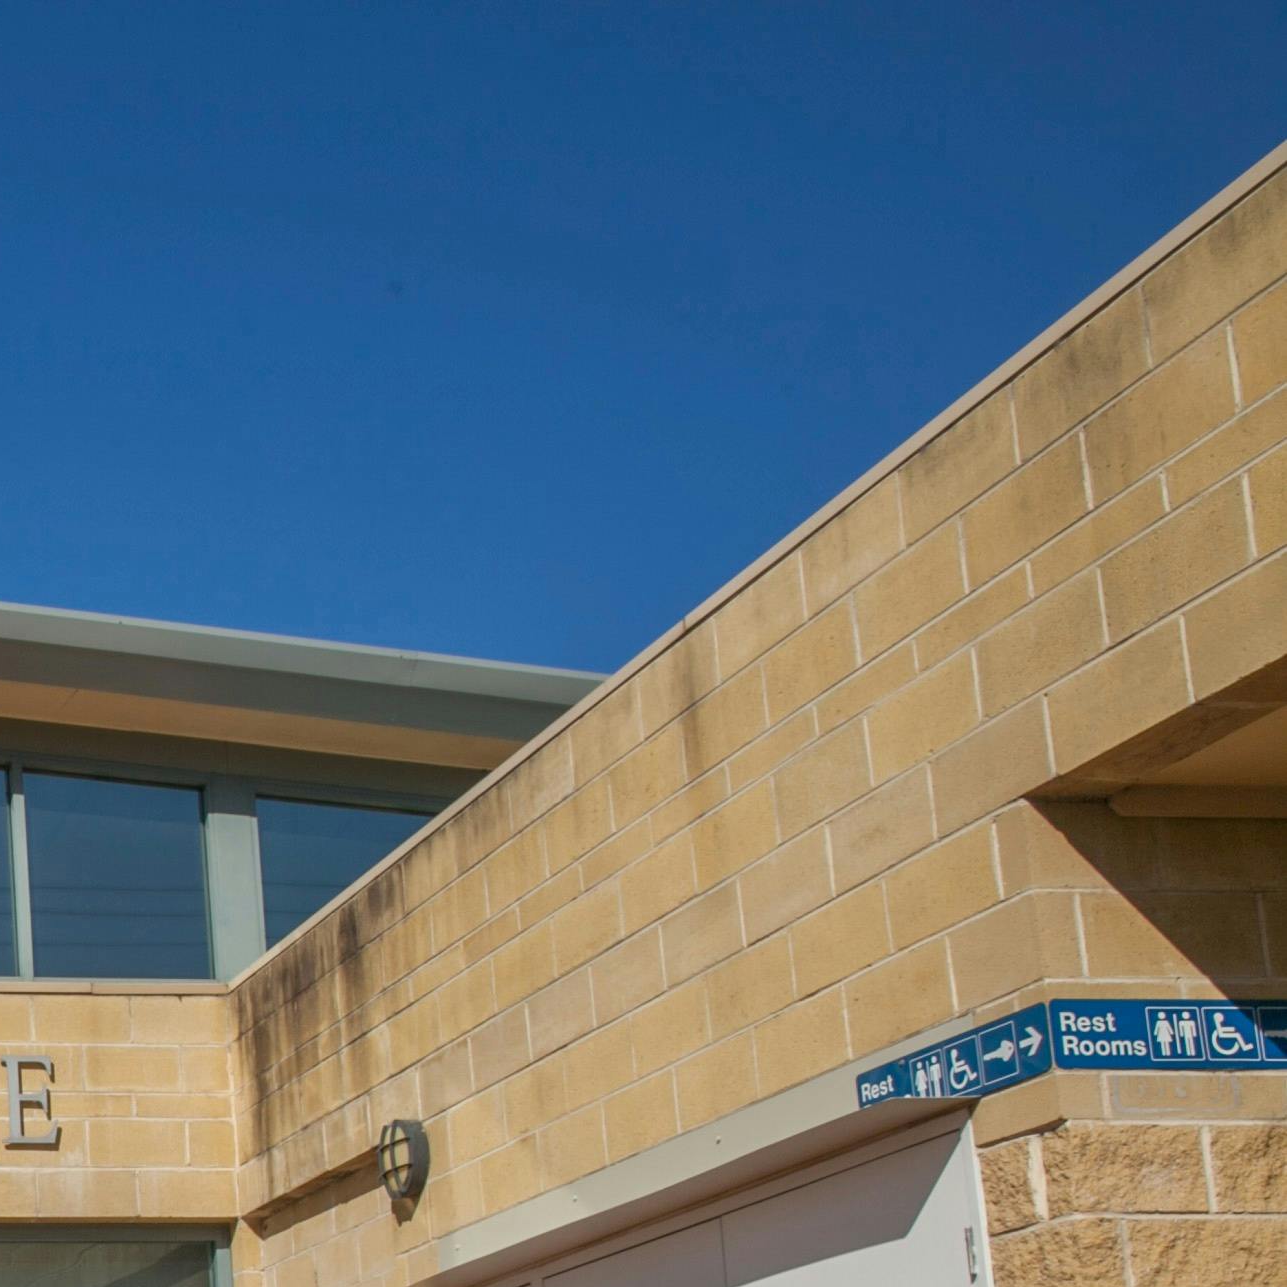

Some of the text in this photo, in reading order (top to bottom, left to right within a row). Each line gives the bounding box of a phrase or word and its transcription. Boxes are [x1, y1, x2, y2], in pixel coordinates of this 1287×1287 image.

[1060, 1012, 1117, 1033] Rest
[1061, 1035, 1148, 1058] Rooms
[861, 1074, 895, 1104] Rest
